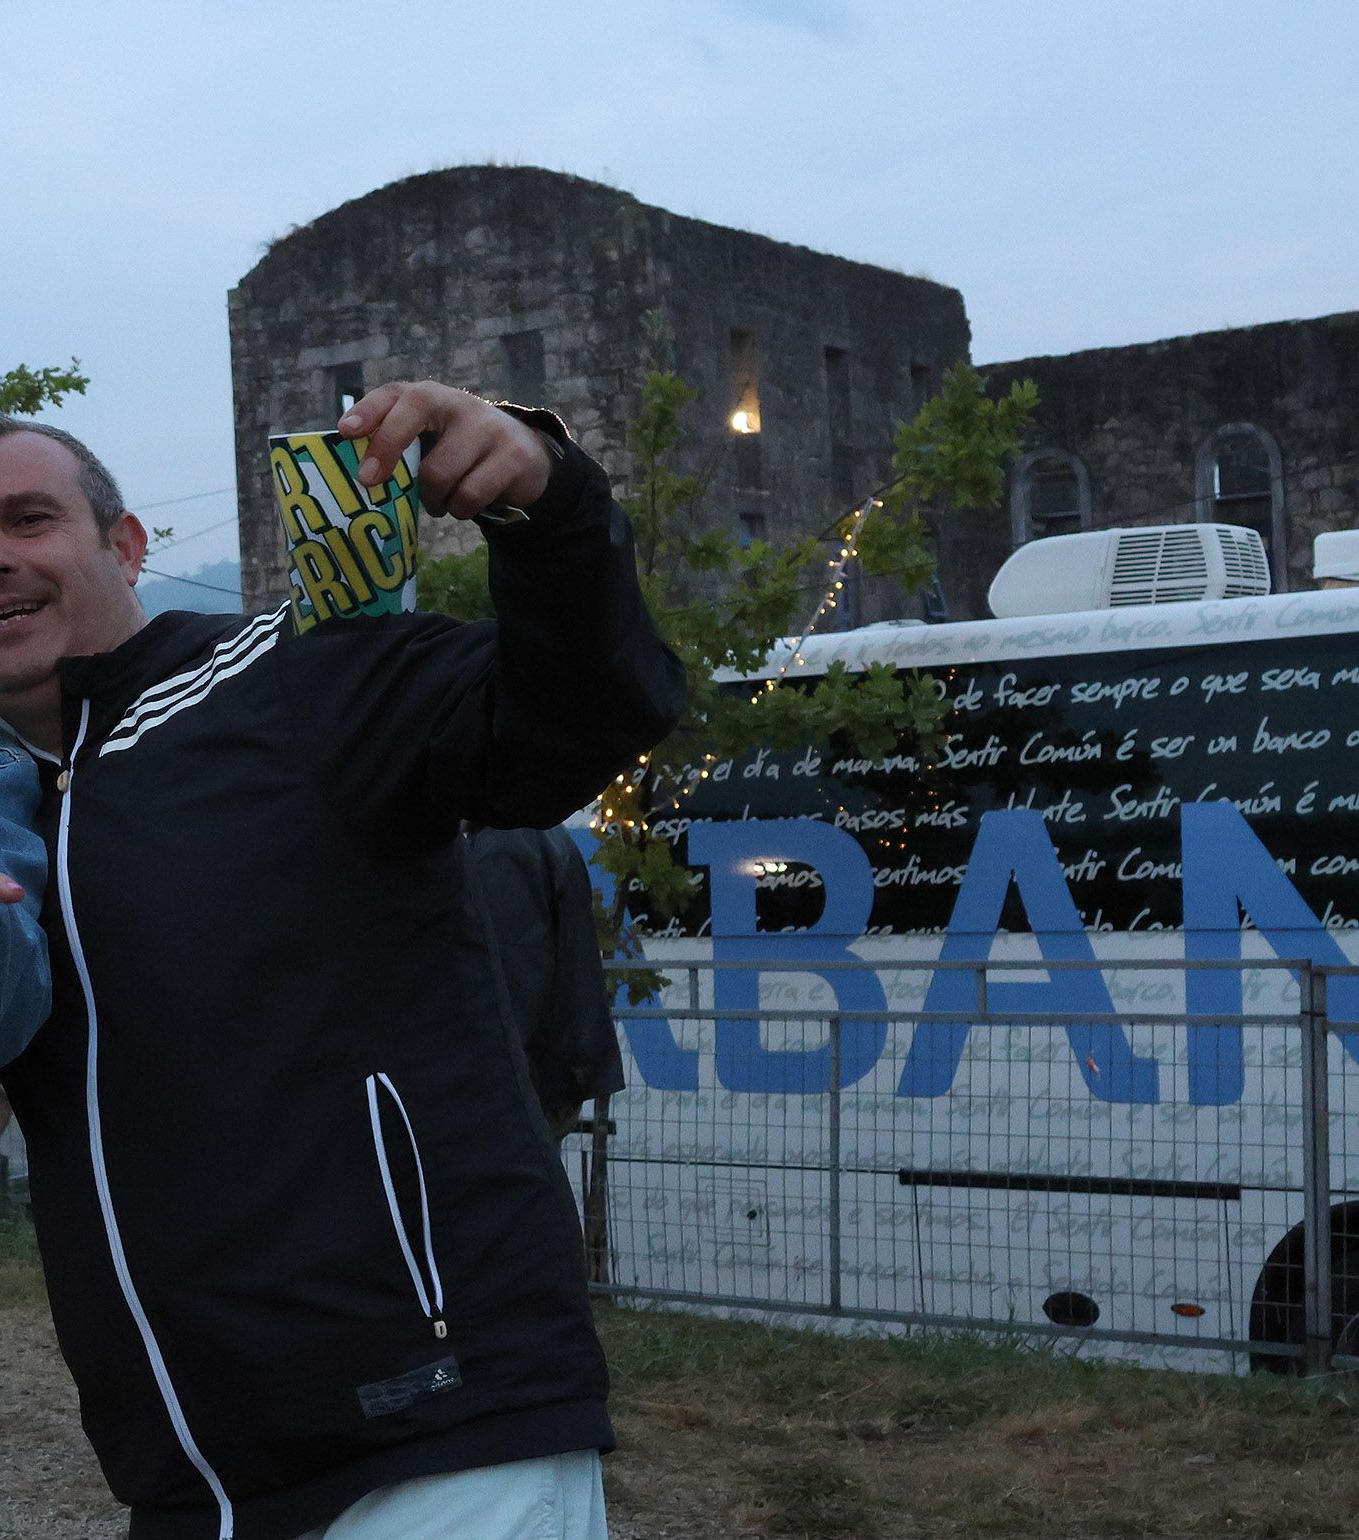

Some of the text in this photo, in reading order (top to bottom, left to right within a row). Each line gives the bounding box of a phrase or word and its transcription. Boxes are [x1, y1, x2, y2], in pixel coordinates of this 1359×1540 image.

[954, 677, 984, 711] de
[993, 672, 1062, 711] facer
[1070, 676, 1163, 710] sempre
[1170, 676, 1190, 698] o
[1200, 670, 1249, 703] que
[1261, 666, 1322, 691] sexa
[743, 747, 781, 781] día
[792, 745, 822, 777] de
[935, 733, 1008, 769] Sentir
[1019, 729, 1102, 766] Común
[1116, 728, 1139, 761] é
[1150, 734, 1195, 759] ser
[1207, 735, 1237, 756] un
[1252, 716, 1331, 754] banco
[916, 800, 970, 828] más
[1103, 783, 1181, 821] Sentir
[1295, 780, 1320, 815] é
